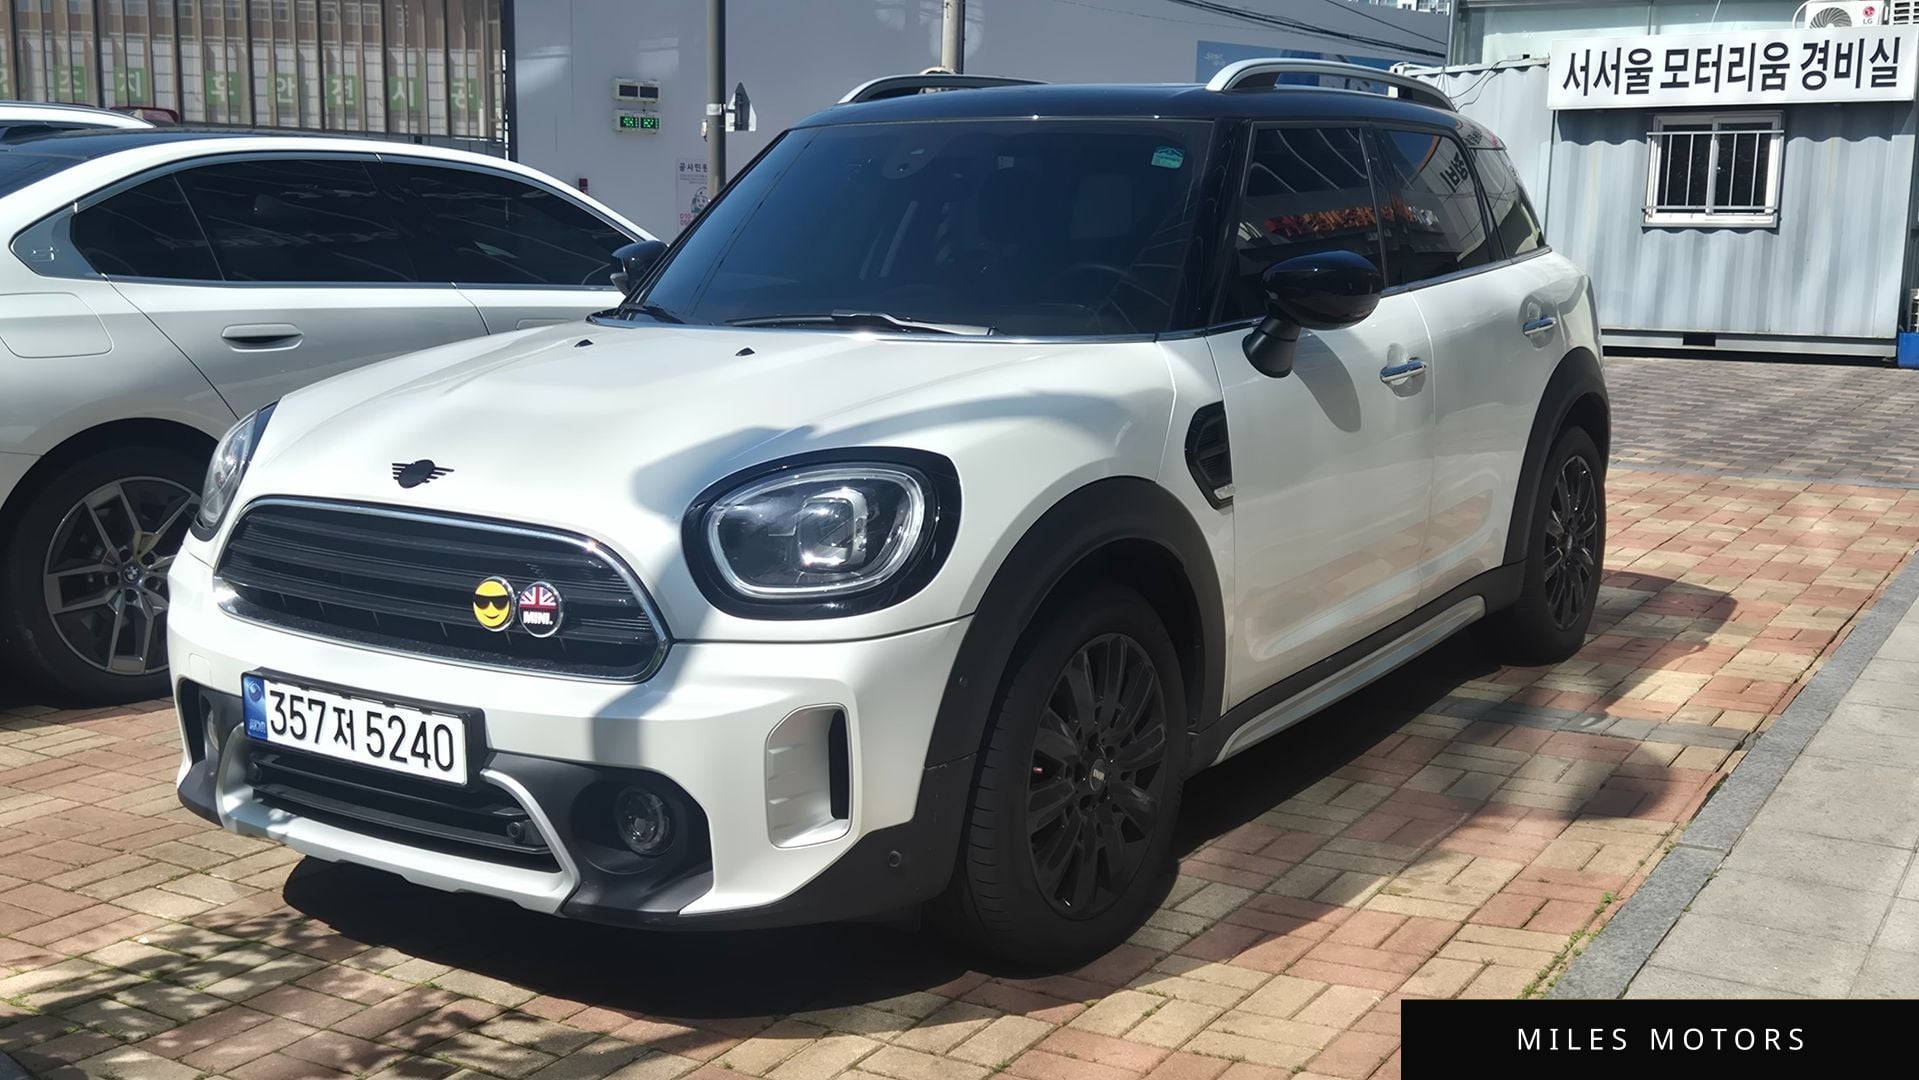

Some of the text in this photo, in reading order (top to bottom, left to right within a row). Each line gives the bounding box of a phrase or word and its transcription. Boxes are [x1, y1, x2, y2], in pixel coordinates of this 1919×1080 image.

[1562, 36, 1901, 97] 서서울 모터리움 경비실
[269, 690, 454, 772] 357저 5240
